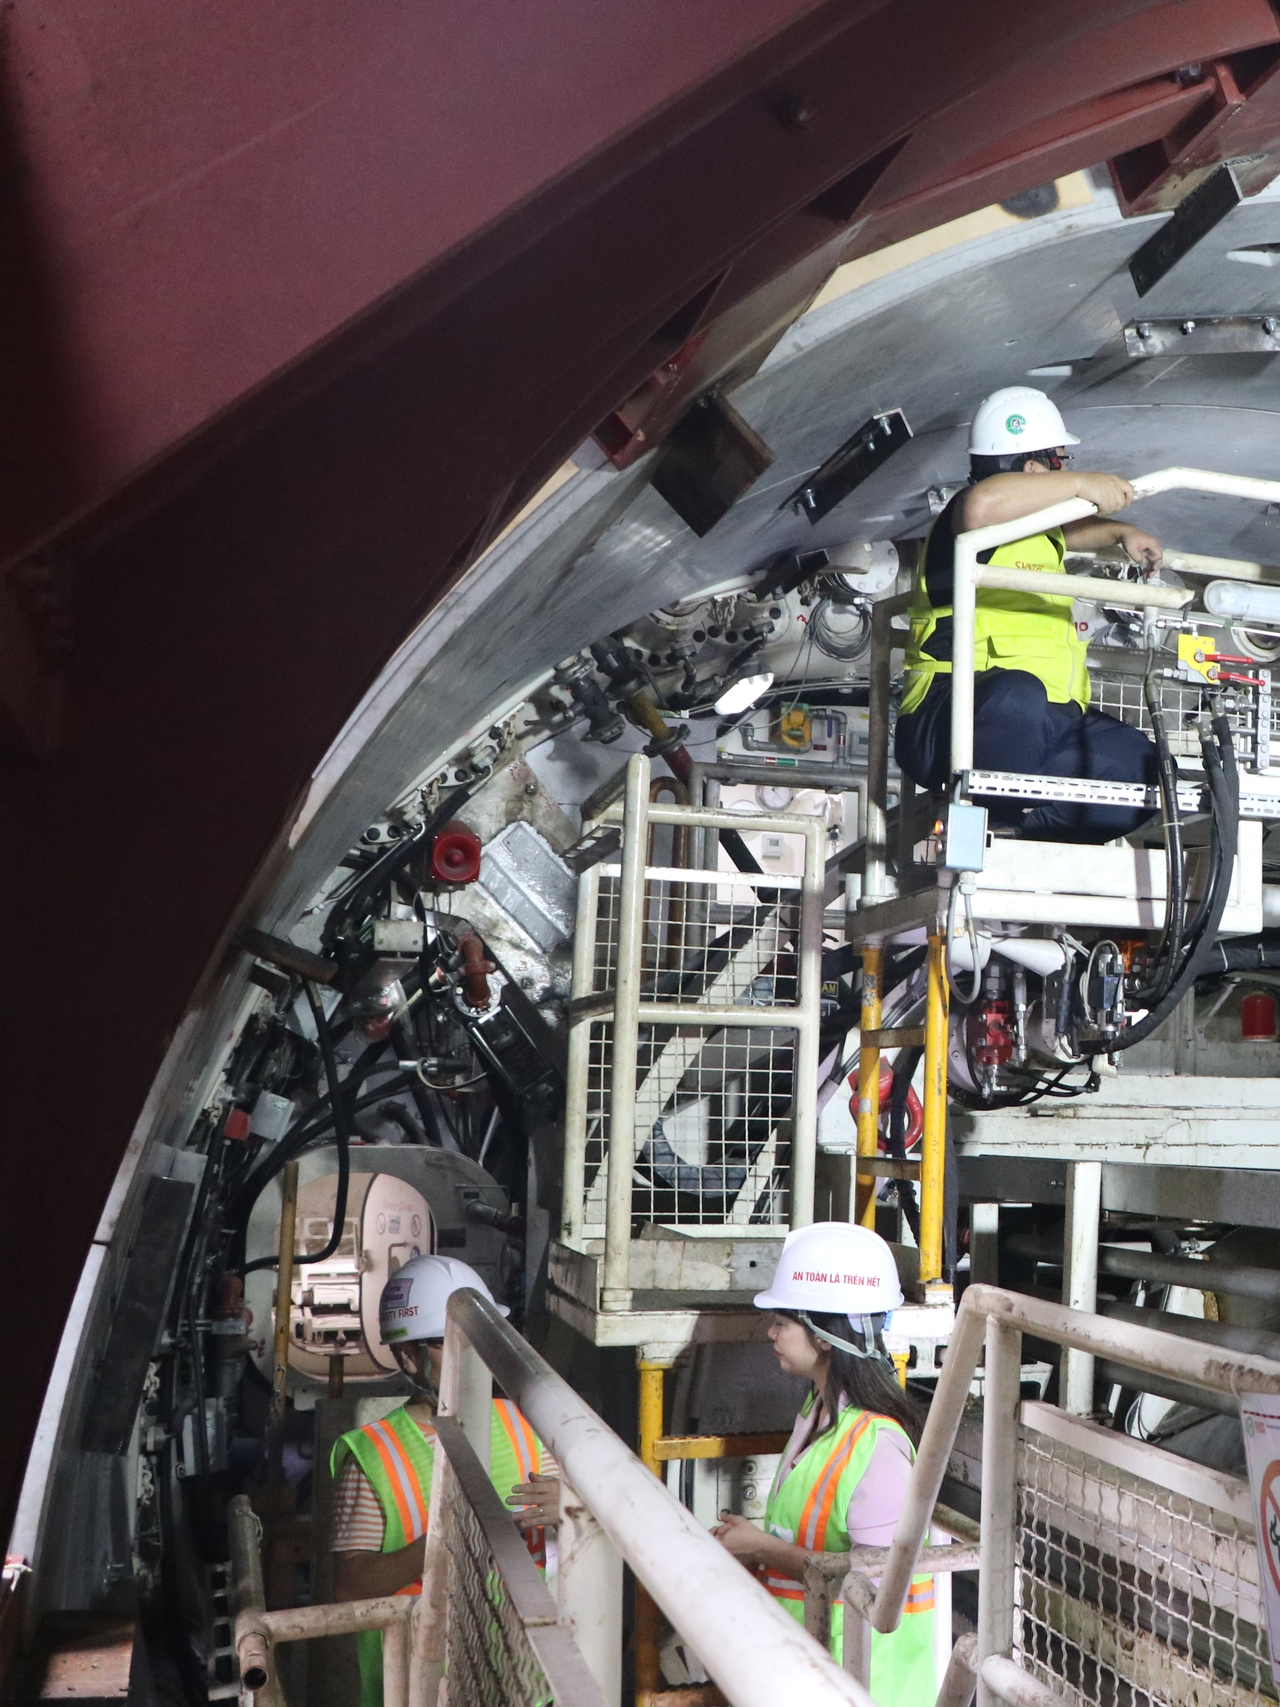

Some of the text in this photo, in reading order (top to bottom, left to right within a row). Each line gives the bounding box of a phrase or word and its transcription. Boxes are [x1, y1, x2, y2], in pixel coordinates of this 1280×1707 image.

[792, 1270, 881, 1288] AN TOÀN LÀ TRÊN HẾT
[398, 1305, 419, 1319] FIRST
